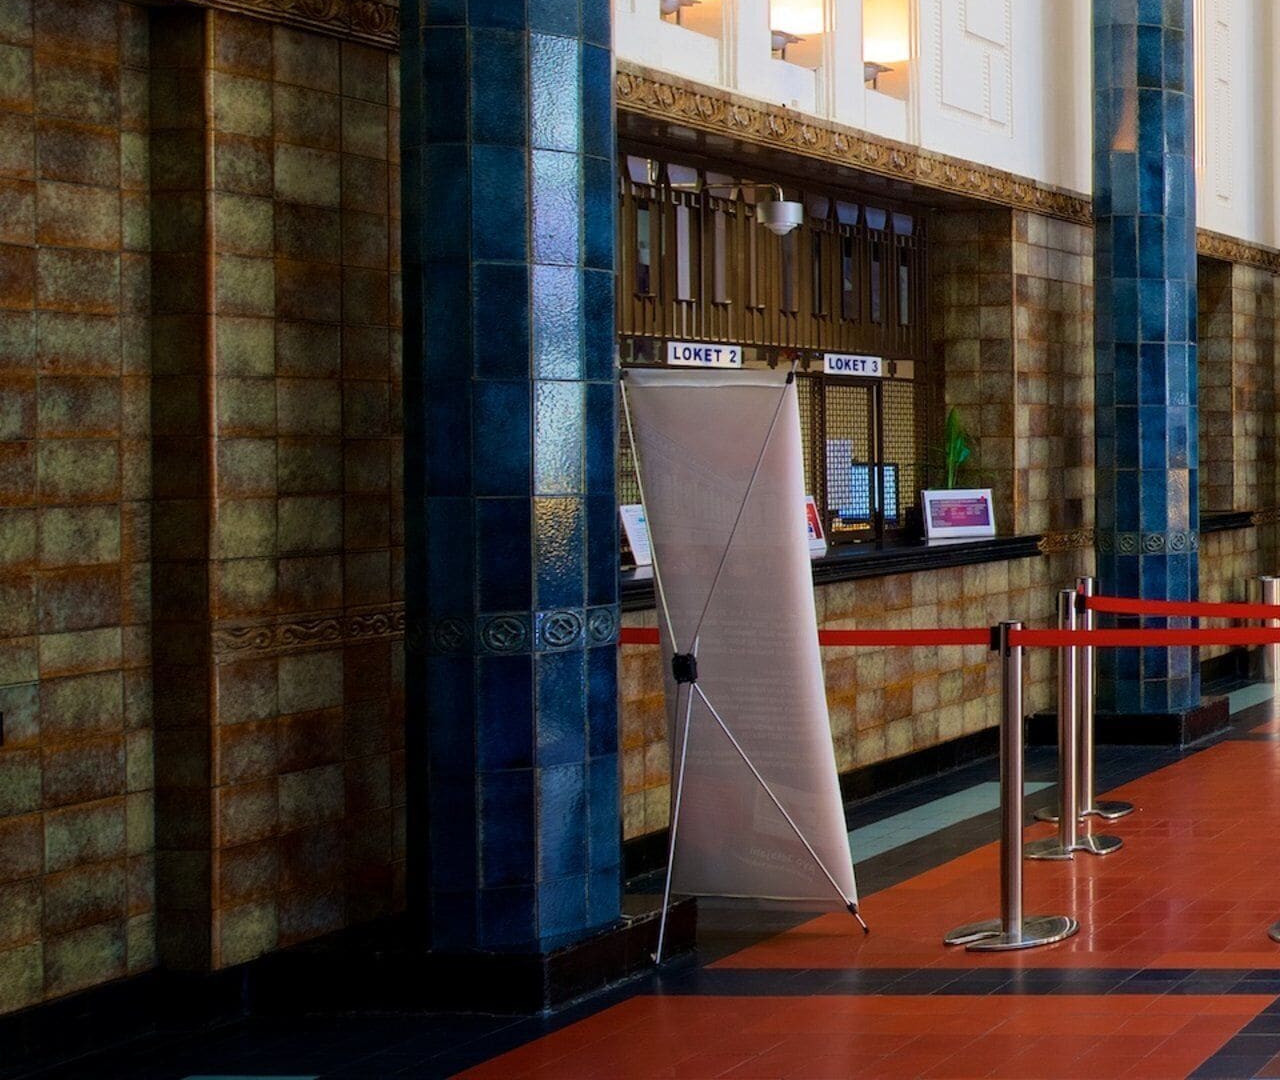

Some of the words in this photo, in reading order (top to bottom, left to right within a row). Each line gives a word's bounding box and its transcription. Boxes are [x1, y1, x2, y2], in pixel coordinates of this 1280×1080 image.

[673, 346, 722, 363] LOKET
[729, 350, 737, 363] 2
[828, 357, 867, 372] LOKET
[872, 360, 879, 373] 3
